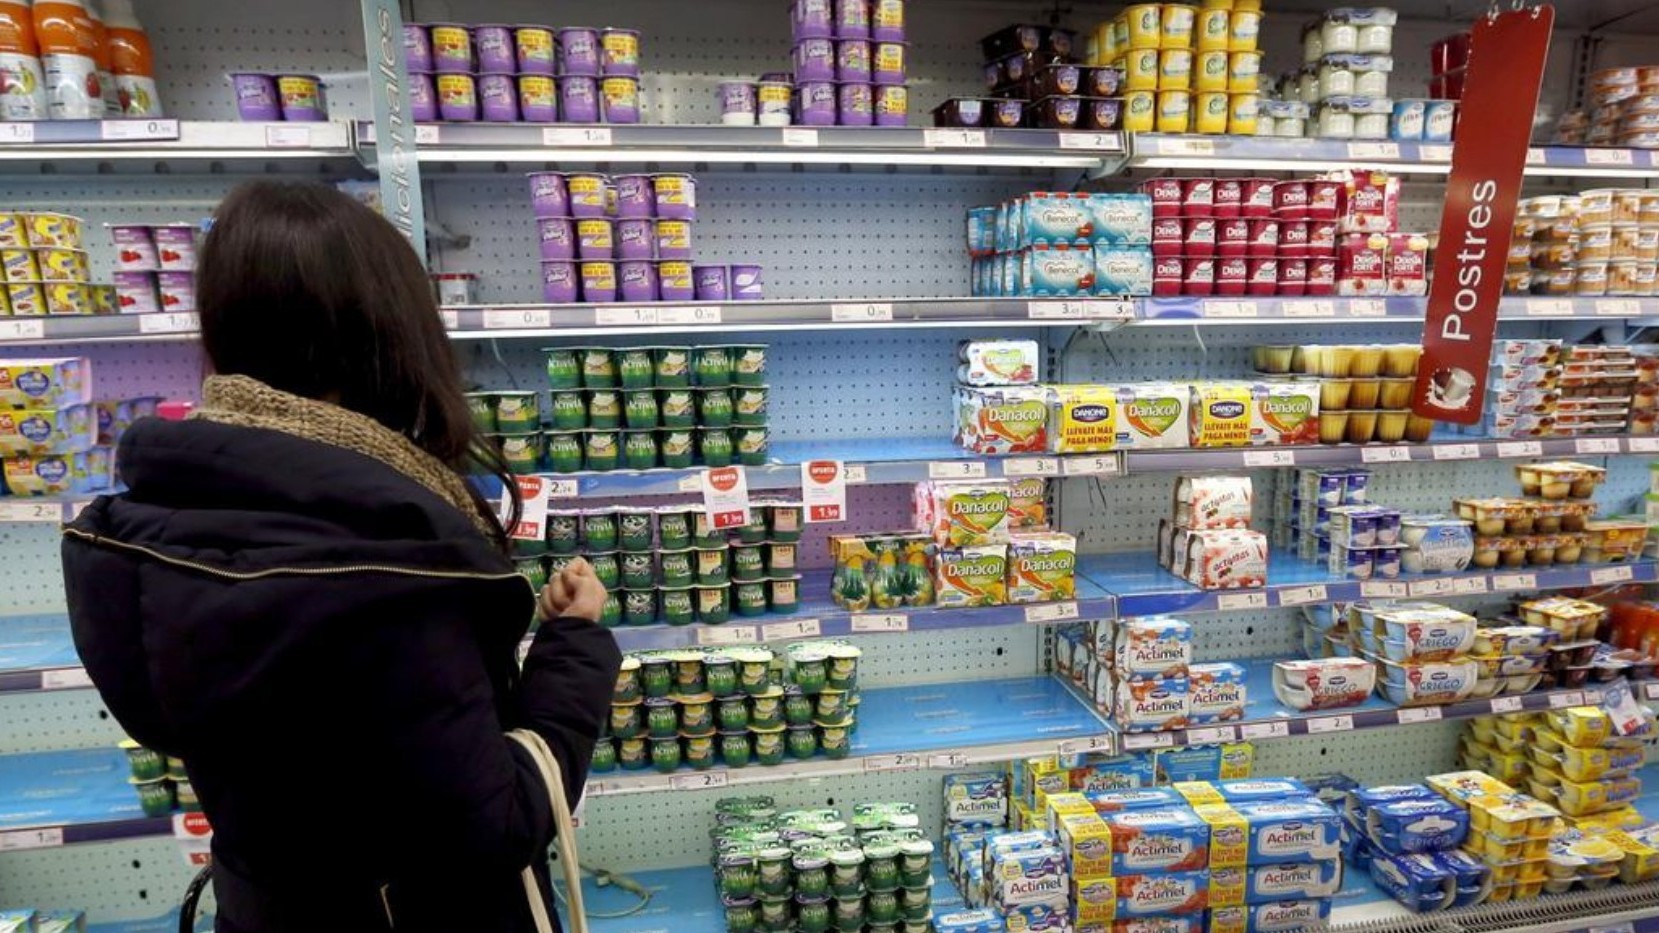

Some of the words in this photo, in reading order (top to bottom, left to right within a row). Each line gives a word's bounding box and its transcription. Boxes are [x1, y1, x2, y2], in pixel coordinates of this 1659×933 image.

[1441, 180, 1497, 341] Postres
[1129, 404, 1175, 417] Danacol
[1263, 400, 1309, 412] Danacol
[988, 408, 1041, 422] Danacol
[952, 500, 1004, 515] Danacol
[948, 563, 1001, 577] Danacol
[1021, 555, 1072, 572] Danacol
[1135, 648, 1184, 661] Actimel
[1419, 680, 1460, 692] GRIEGO
[1192, 690, 1240, 705] Actimel
[1134, 700, 1183, 713] Actimel
[1087, 780, 1132, 792] Actimel
[955, 800, 1001, 813] Actimel
[1266, 829, 1316, 843] Actimel
[1131, 844, 1183, 857] Actimel
[1263, 870, 1312, 884] Actimel
[1009, 876, 1063, 894] Actimel
[1135, 887, 1187, 902] Actimel
[1264, 907, 1312, 922] Actimel
